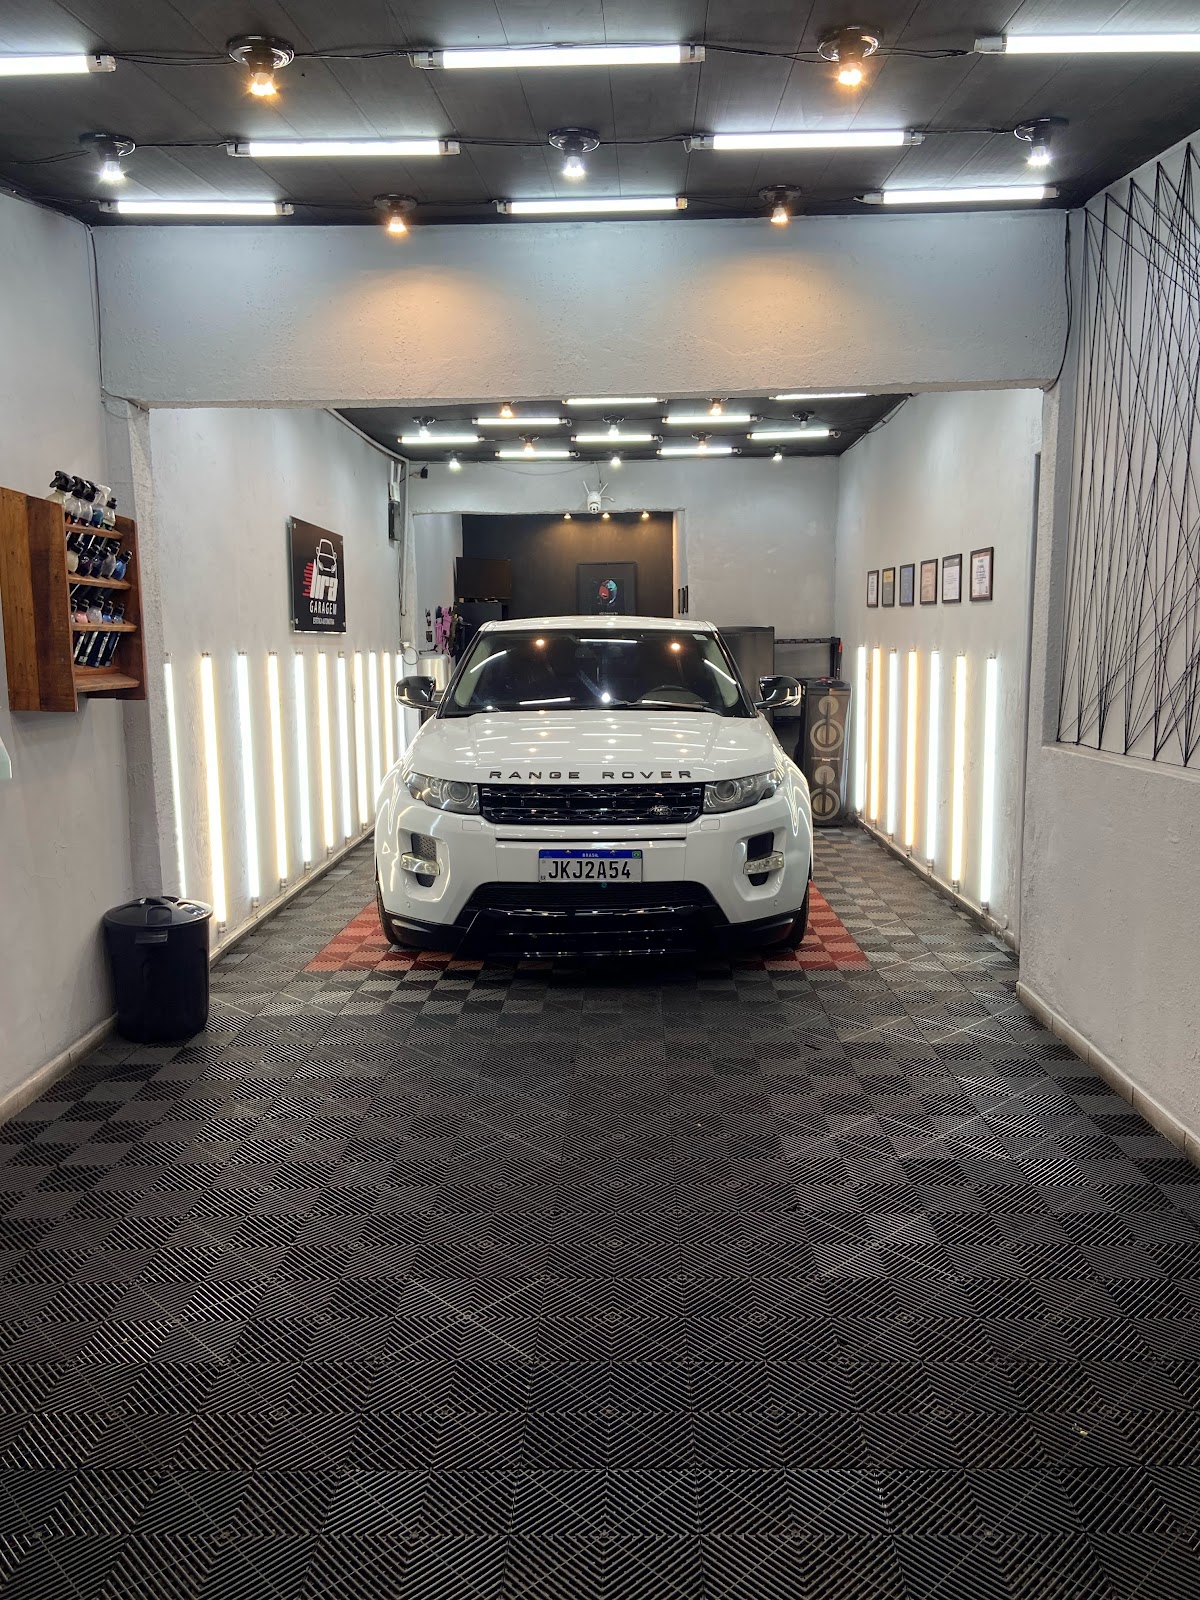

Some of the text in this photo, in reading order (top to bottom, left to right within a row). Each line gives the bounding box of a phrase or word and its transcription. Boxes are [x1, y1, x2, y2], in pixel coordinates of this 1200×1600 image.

[309, 600, 337, 615] GARAGEM
[489, 771, 692, 779] RANGE ROVER
[548, 861, 631, 879] JKJ2A54
